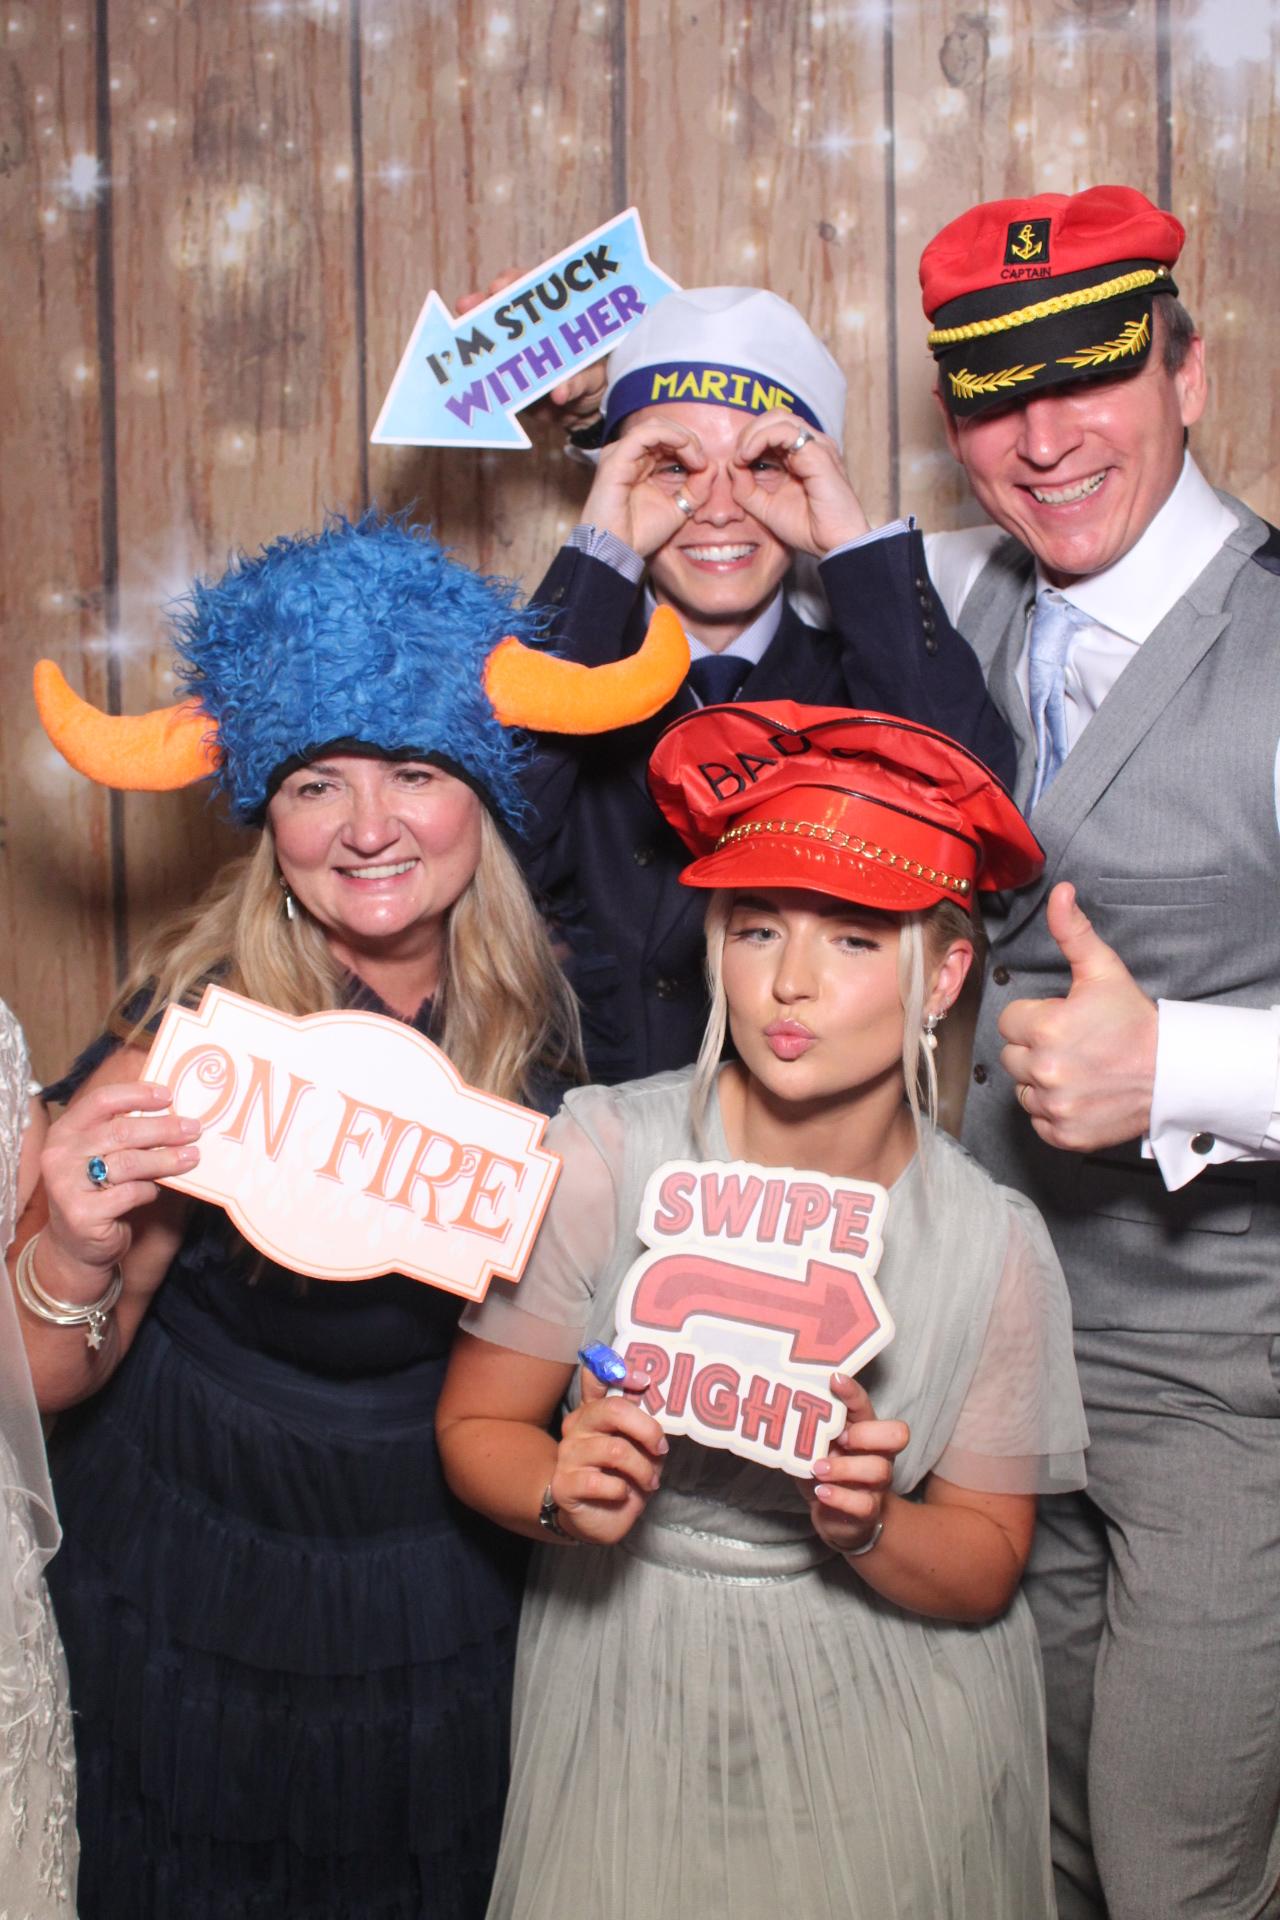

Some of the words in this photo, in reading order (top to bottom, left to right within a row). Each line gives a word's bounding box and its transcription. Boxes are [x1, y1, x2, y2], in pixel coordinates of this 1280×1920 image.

[494, 244, 619, 340] STUCK
[1000, 267, 1051, 279] CAPTAIN
[444, 336, 563, 428] WITH
[558, 284, 648, 355] HER
[168, 1043, 316, 1162] ON
[314, 1090, 528, 1243] FIRE
[653, 1171, 875, 1258] SWIPE
[623, 1341, 833, 1461] RIGHT
